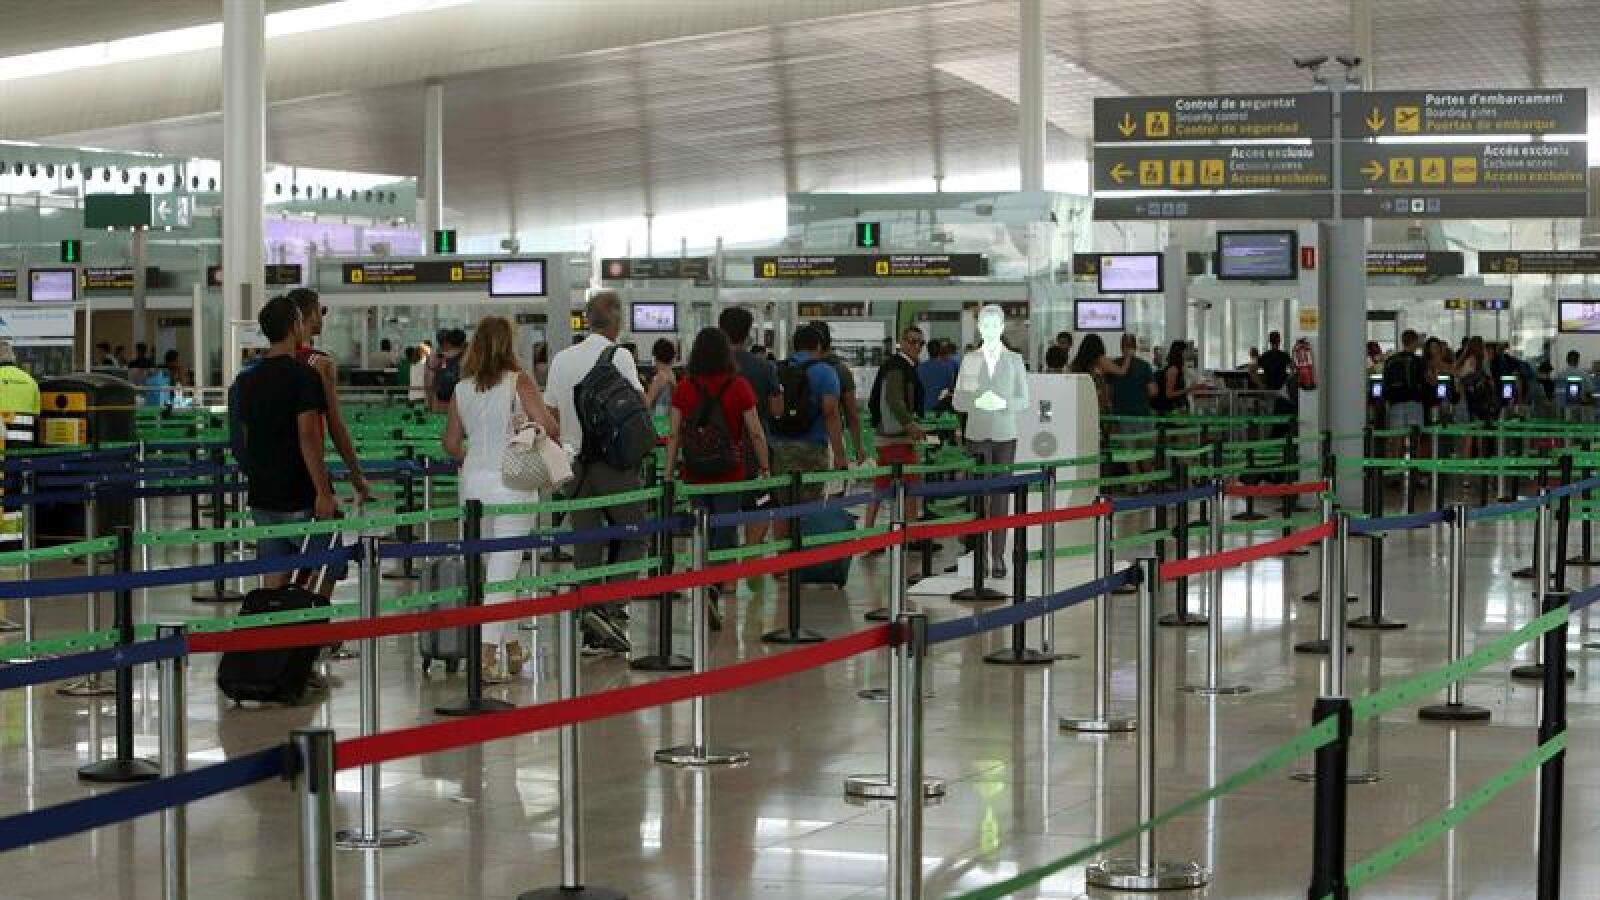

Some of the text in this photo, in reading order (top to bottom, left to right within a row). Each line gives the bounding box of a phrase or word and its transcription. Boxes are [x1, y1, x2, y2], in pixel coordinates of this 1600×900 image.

[1175, 97, 1297, 110] Control de seguretat
[1426, 94, 1464, 105] Portes
